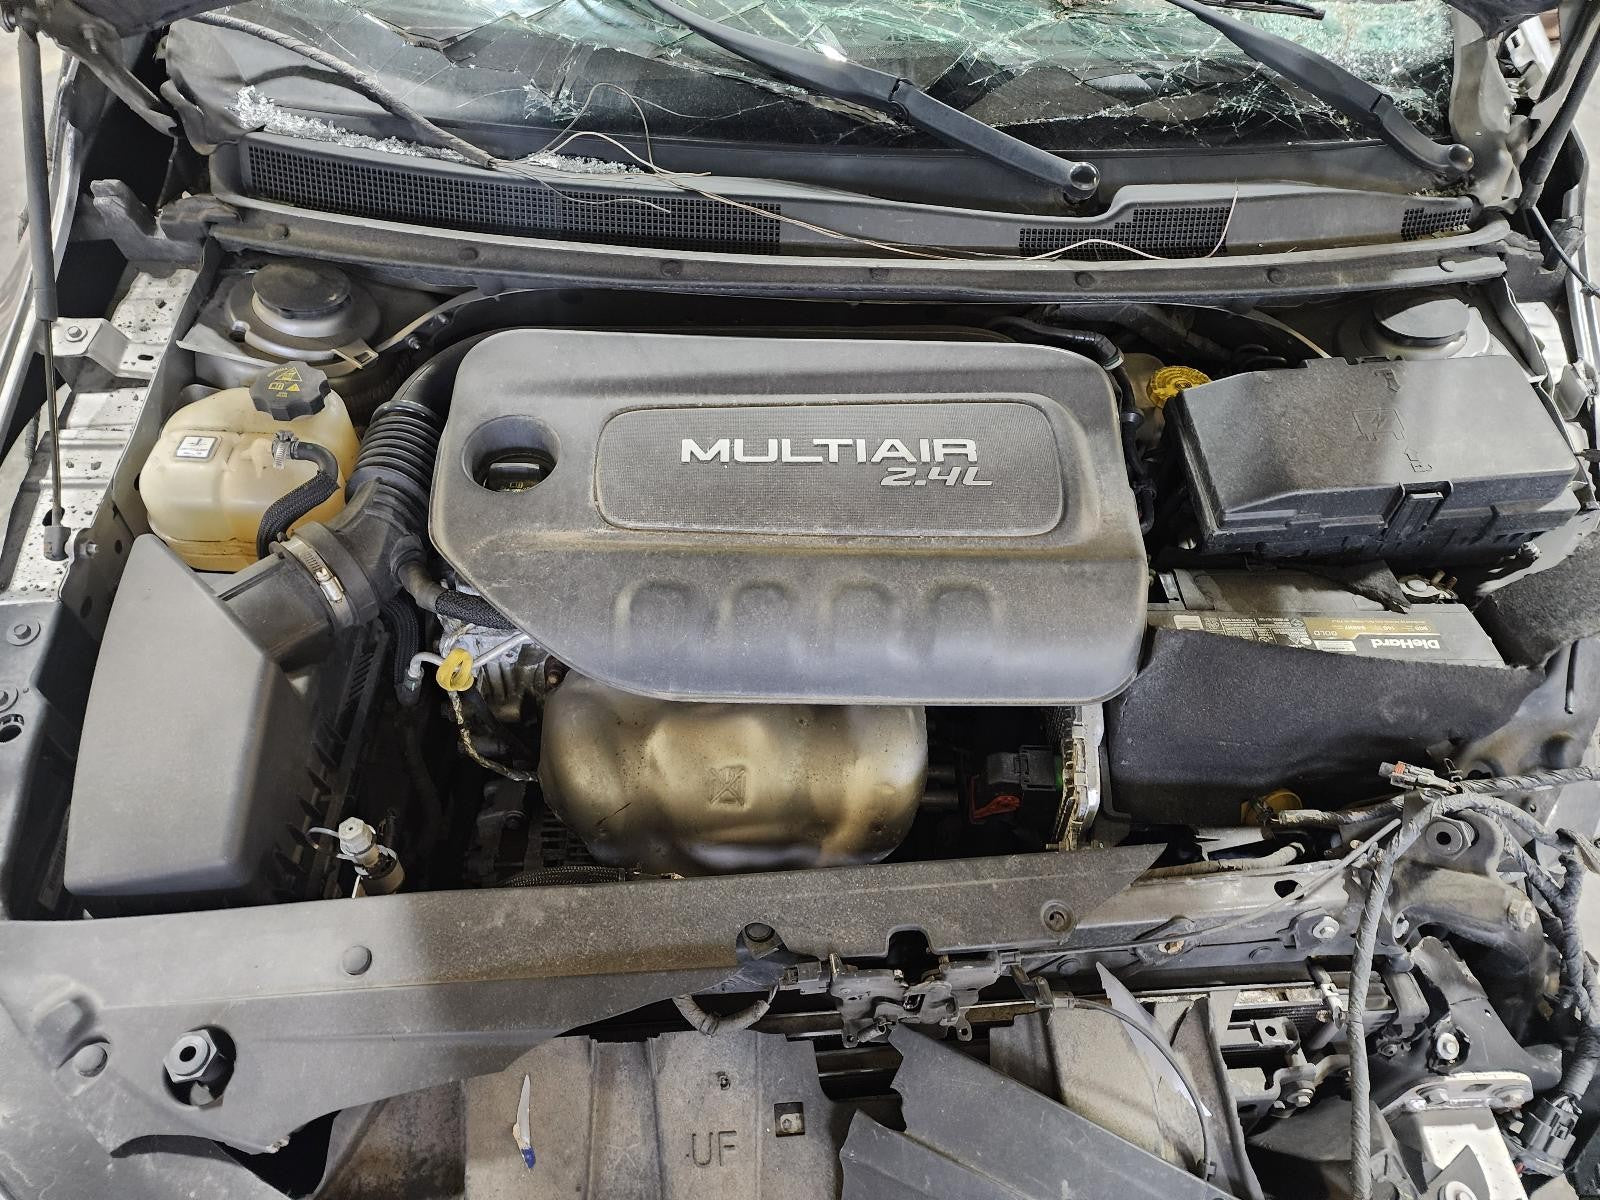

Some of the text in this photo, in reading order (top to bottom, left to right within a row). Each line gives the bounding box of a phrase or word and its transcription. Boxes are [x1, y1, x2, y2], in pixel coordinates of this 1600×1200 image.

[680, 438, 978, 463] MULTIAIR
[880, 466, 993, 487] 2.4L
[1370, 638, 1441, 649] DieHard
[691, 1130, 737, 1167] UF
